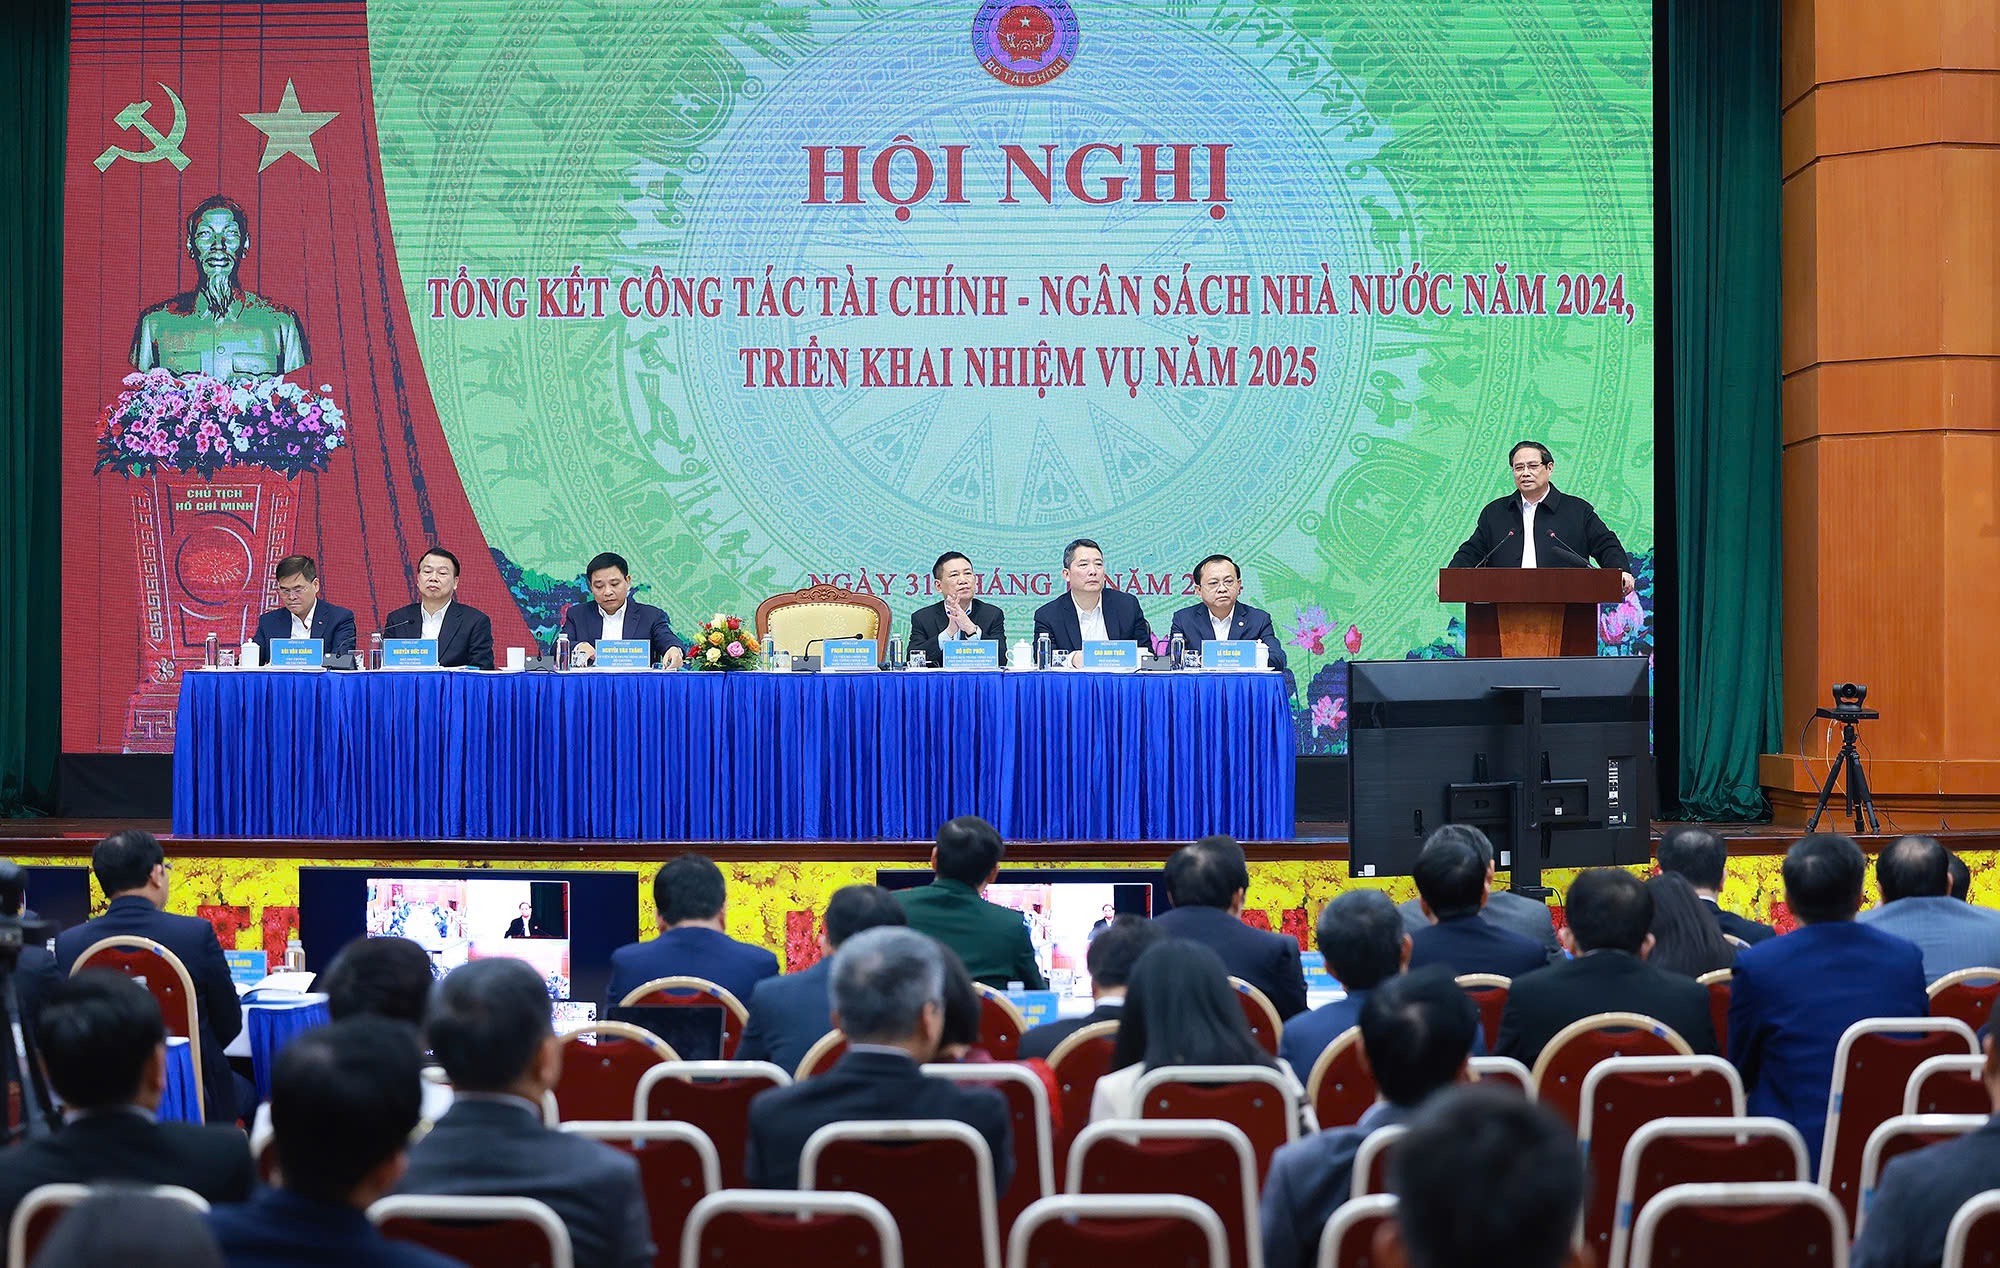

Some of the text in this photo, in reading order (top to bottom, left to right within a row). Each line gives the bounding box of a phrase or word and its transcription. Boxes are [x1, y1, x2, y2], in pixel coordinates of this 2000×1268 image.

[801, 135, 1233, 222] HỘI NGHỊ
[427, 261, 1636, 324] TỔNG KẾT CÔNG TÁC TÀI CHÍNH - NGÂN SÁCH NHÀ NƯỚC NĂM 2024,
[738, 334, 1318, 399] TRIỂN KHAI NHIỆM VỤ NĂM 2025
[175, 500, 254, 511] HỒ CHÍ MINH
[186, 486, 243, 499] CHỦ TỊCH
[808, 567, 898, 596] NGÀY
[905, 573, 934, 596] 31
[1104, 567, 1173, 596] NĂM
